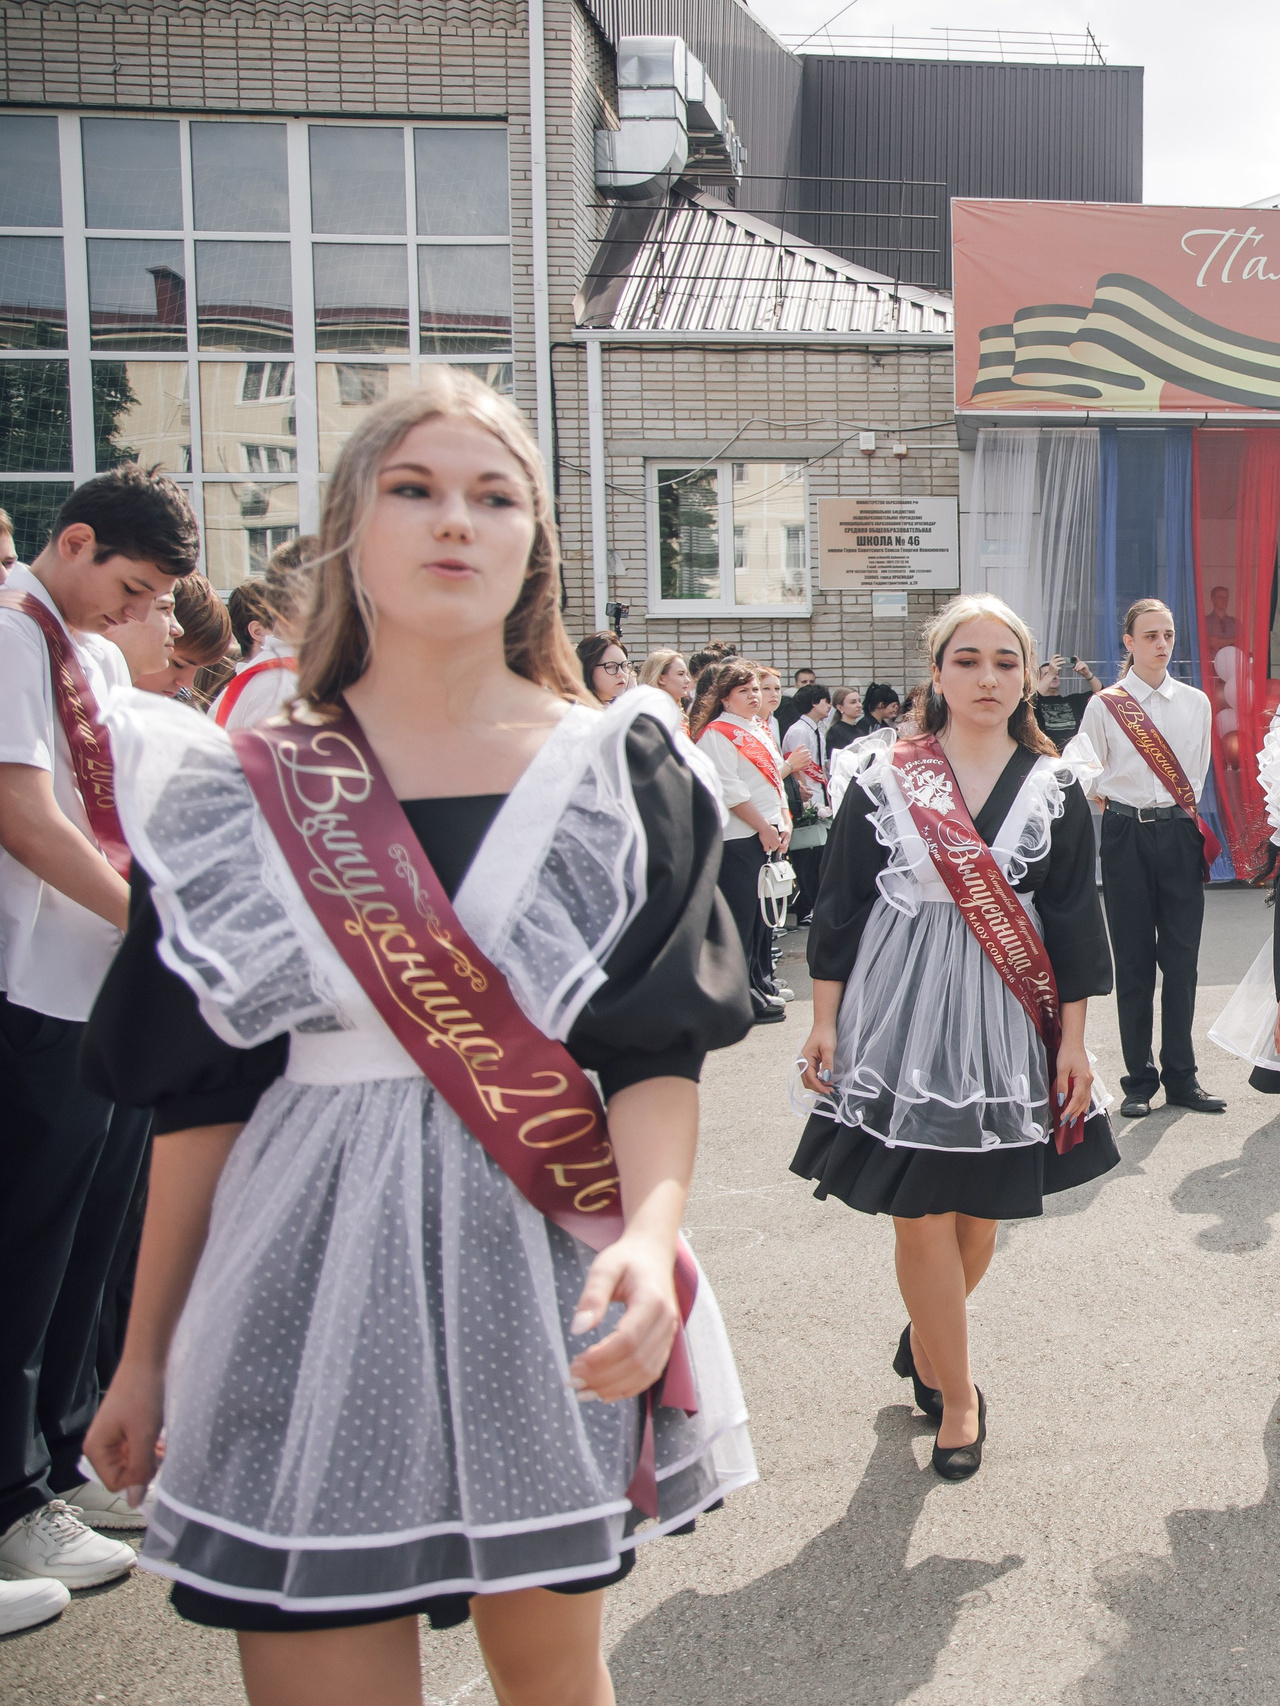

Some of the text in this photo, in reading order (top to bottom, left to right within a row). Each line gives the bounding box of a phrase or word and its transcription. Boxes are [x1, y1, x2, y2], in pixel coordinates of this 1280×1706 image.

[856, 536, 920, 546] ШКОЛА № 46
[1117, 700, 1179, 783] Выпускник
[937, 818, 1033, 974] Выпускница
[278, 731, 620, 1213] Выпускница 2026
[966, 911, 990, 940] МАОУ
[985, 941, 1005, 965] СОШ
